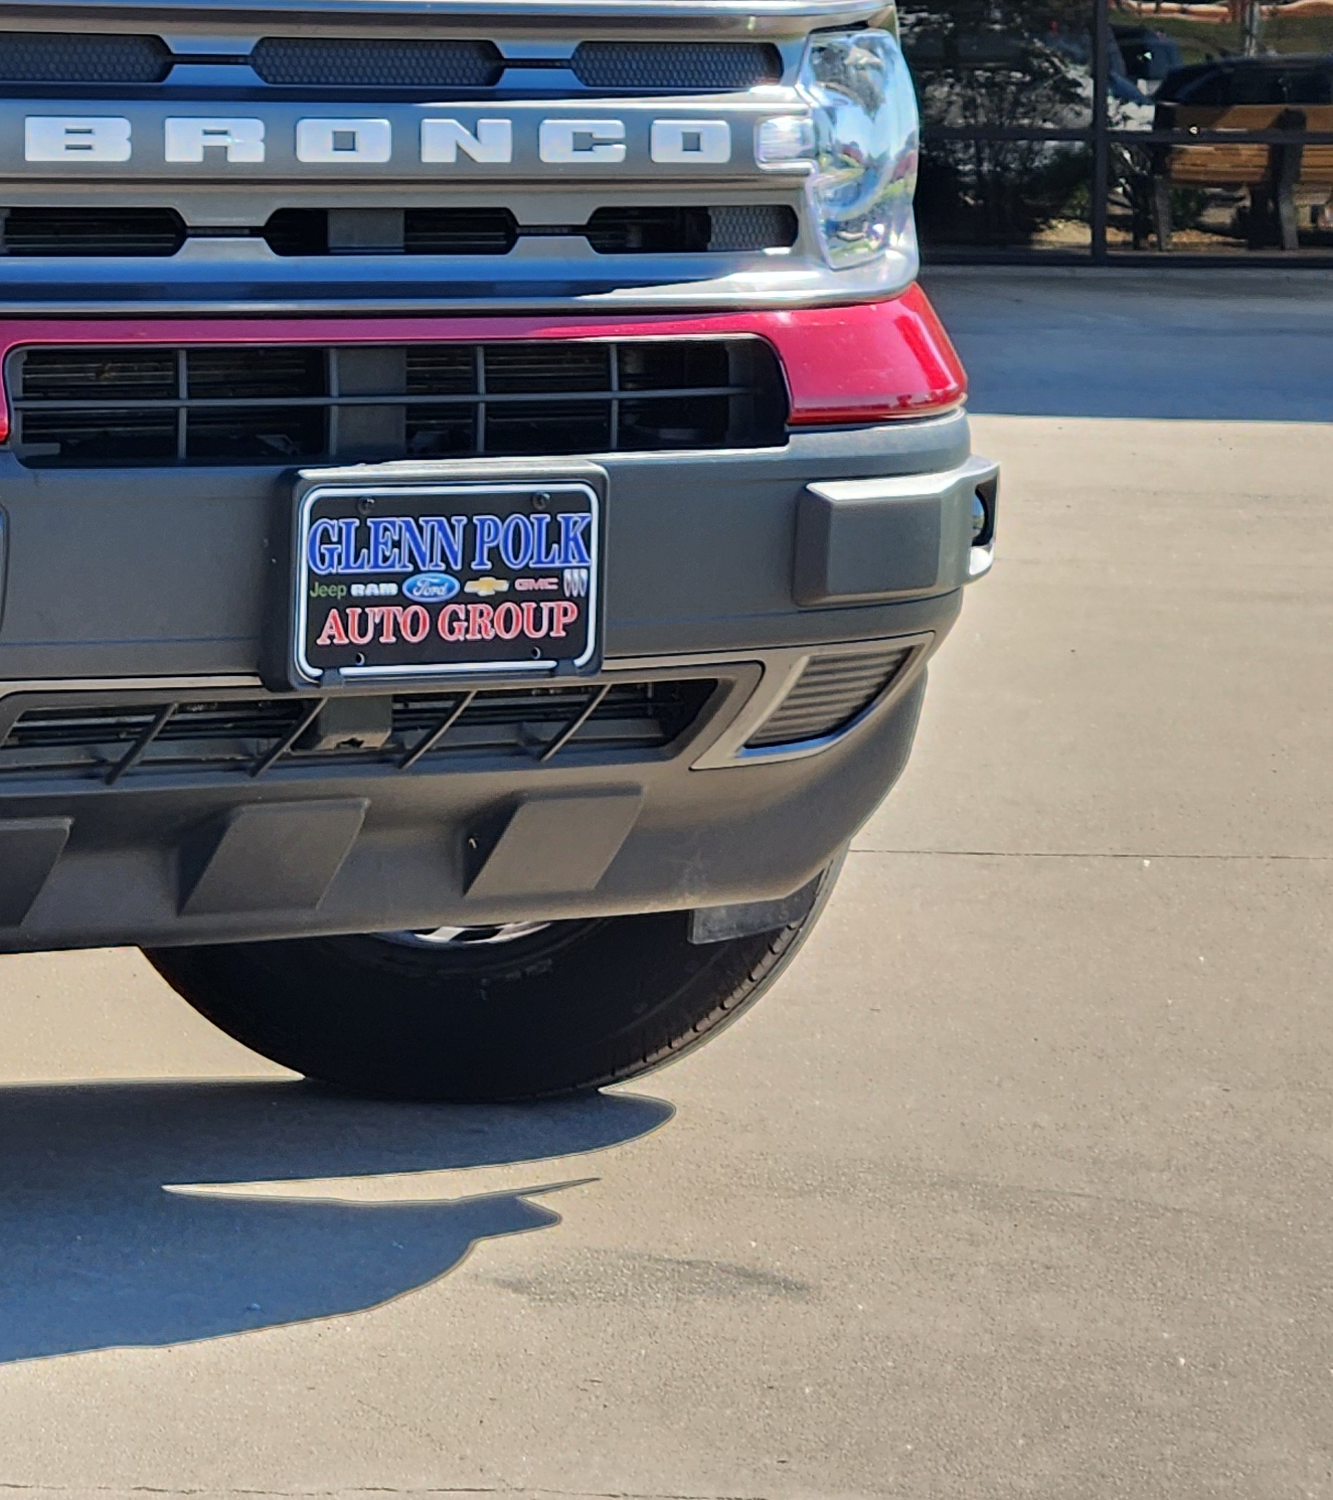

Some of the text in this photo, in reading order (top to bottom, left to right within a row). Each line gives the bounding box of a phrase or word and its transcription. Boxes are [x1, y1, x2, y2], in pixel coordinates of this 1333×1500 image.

[23, 114, 732, 163] BRONCO
[307, 512, 591, 575] GLENN POLK
[309, 581, 347, 599] Jeep
[350, 583, 399, 597] RAM
[514, 577, 559, 591] GMC
[316, 601, 578, 645] AUTO GROUP
